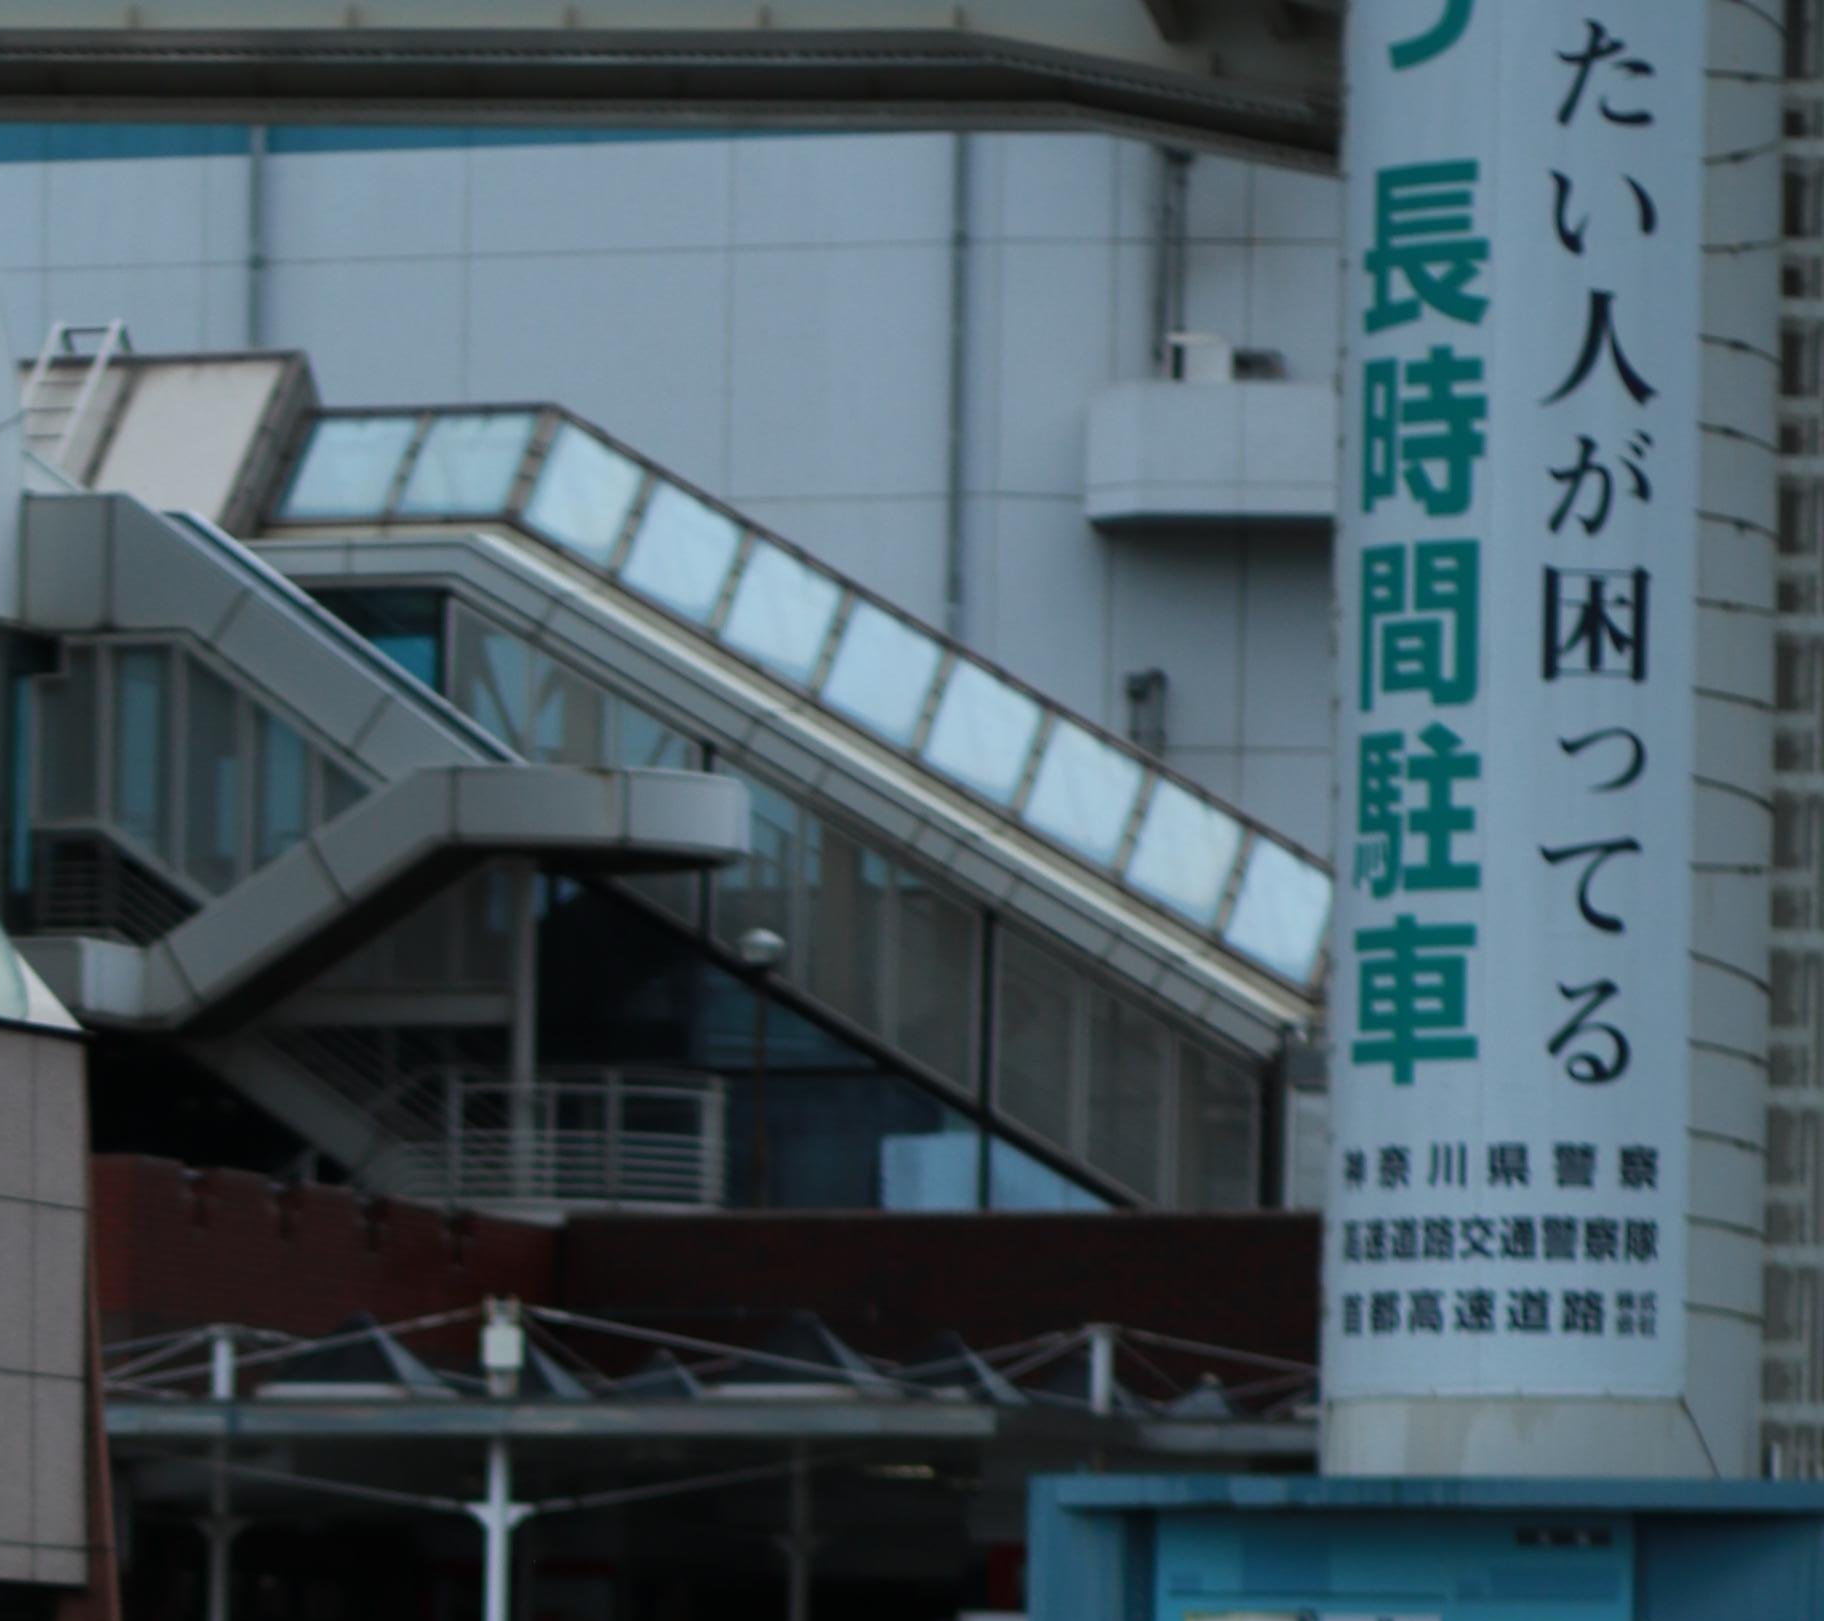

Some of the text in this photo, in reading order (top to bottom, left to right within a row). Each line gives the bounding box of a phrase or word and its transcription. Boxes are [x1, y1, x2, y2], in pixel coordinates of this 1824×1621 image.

[1351, 158, 1490, 1086] 長時間駐車
